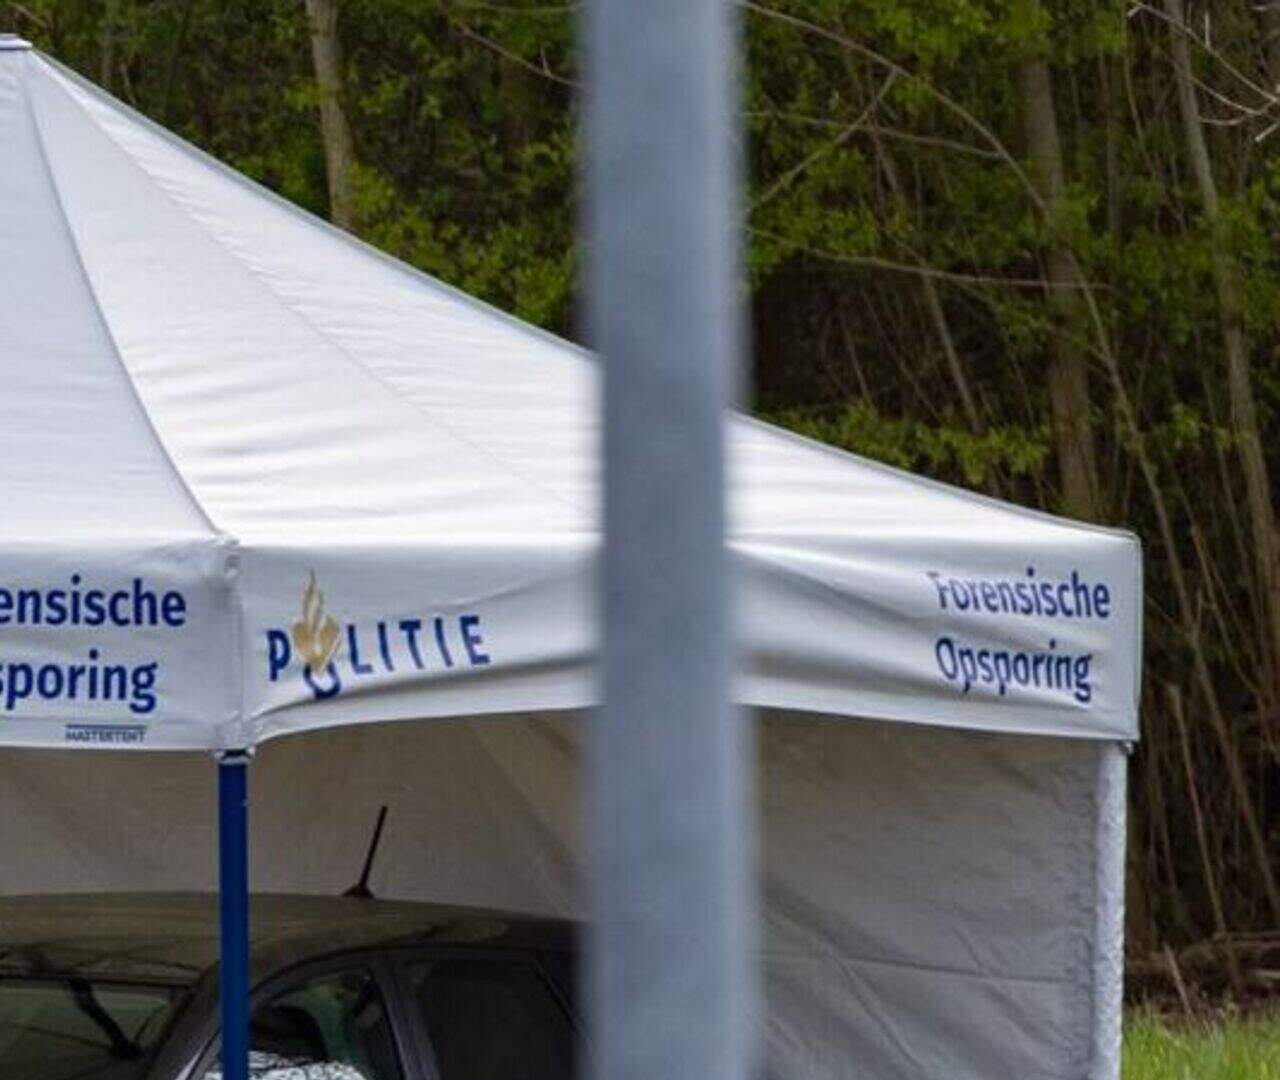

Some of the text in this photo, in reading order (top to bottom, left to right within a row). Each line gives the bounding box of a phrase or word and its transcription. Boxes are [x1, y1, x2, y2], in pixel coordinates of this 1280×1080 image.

[927, 566, 1110, 618] Forensische
[266, 614, 490, 700] POLITIE
[935, 637, 1093, 703] Opsporing
